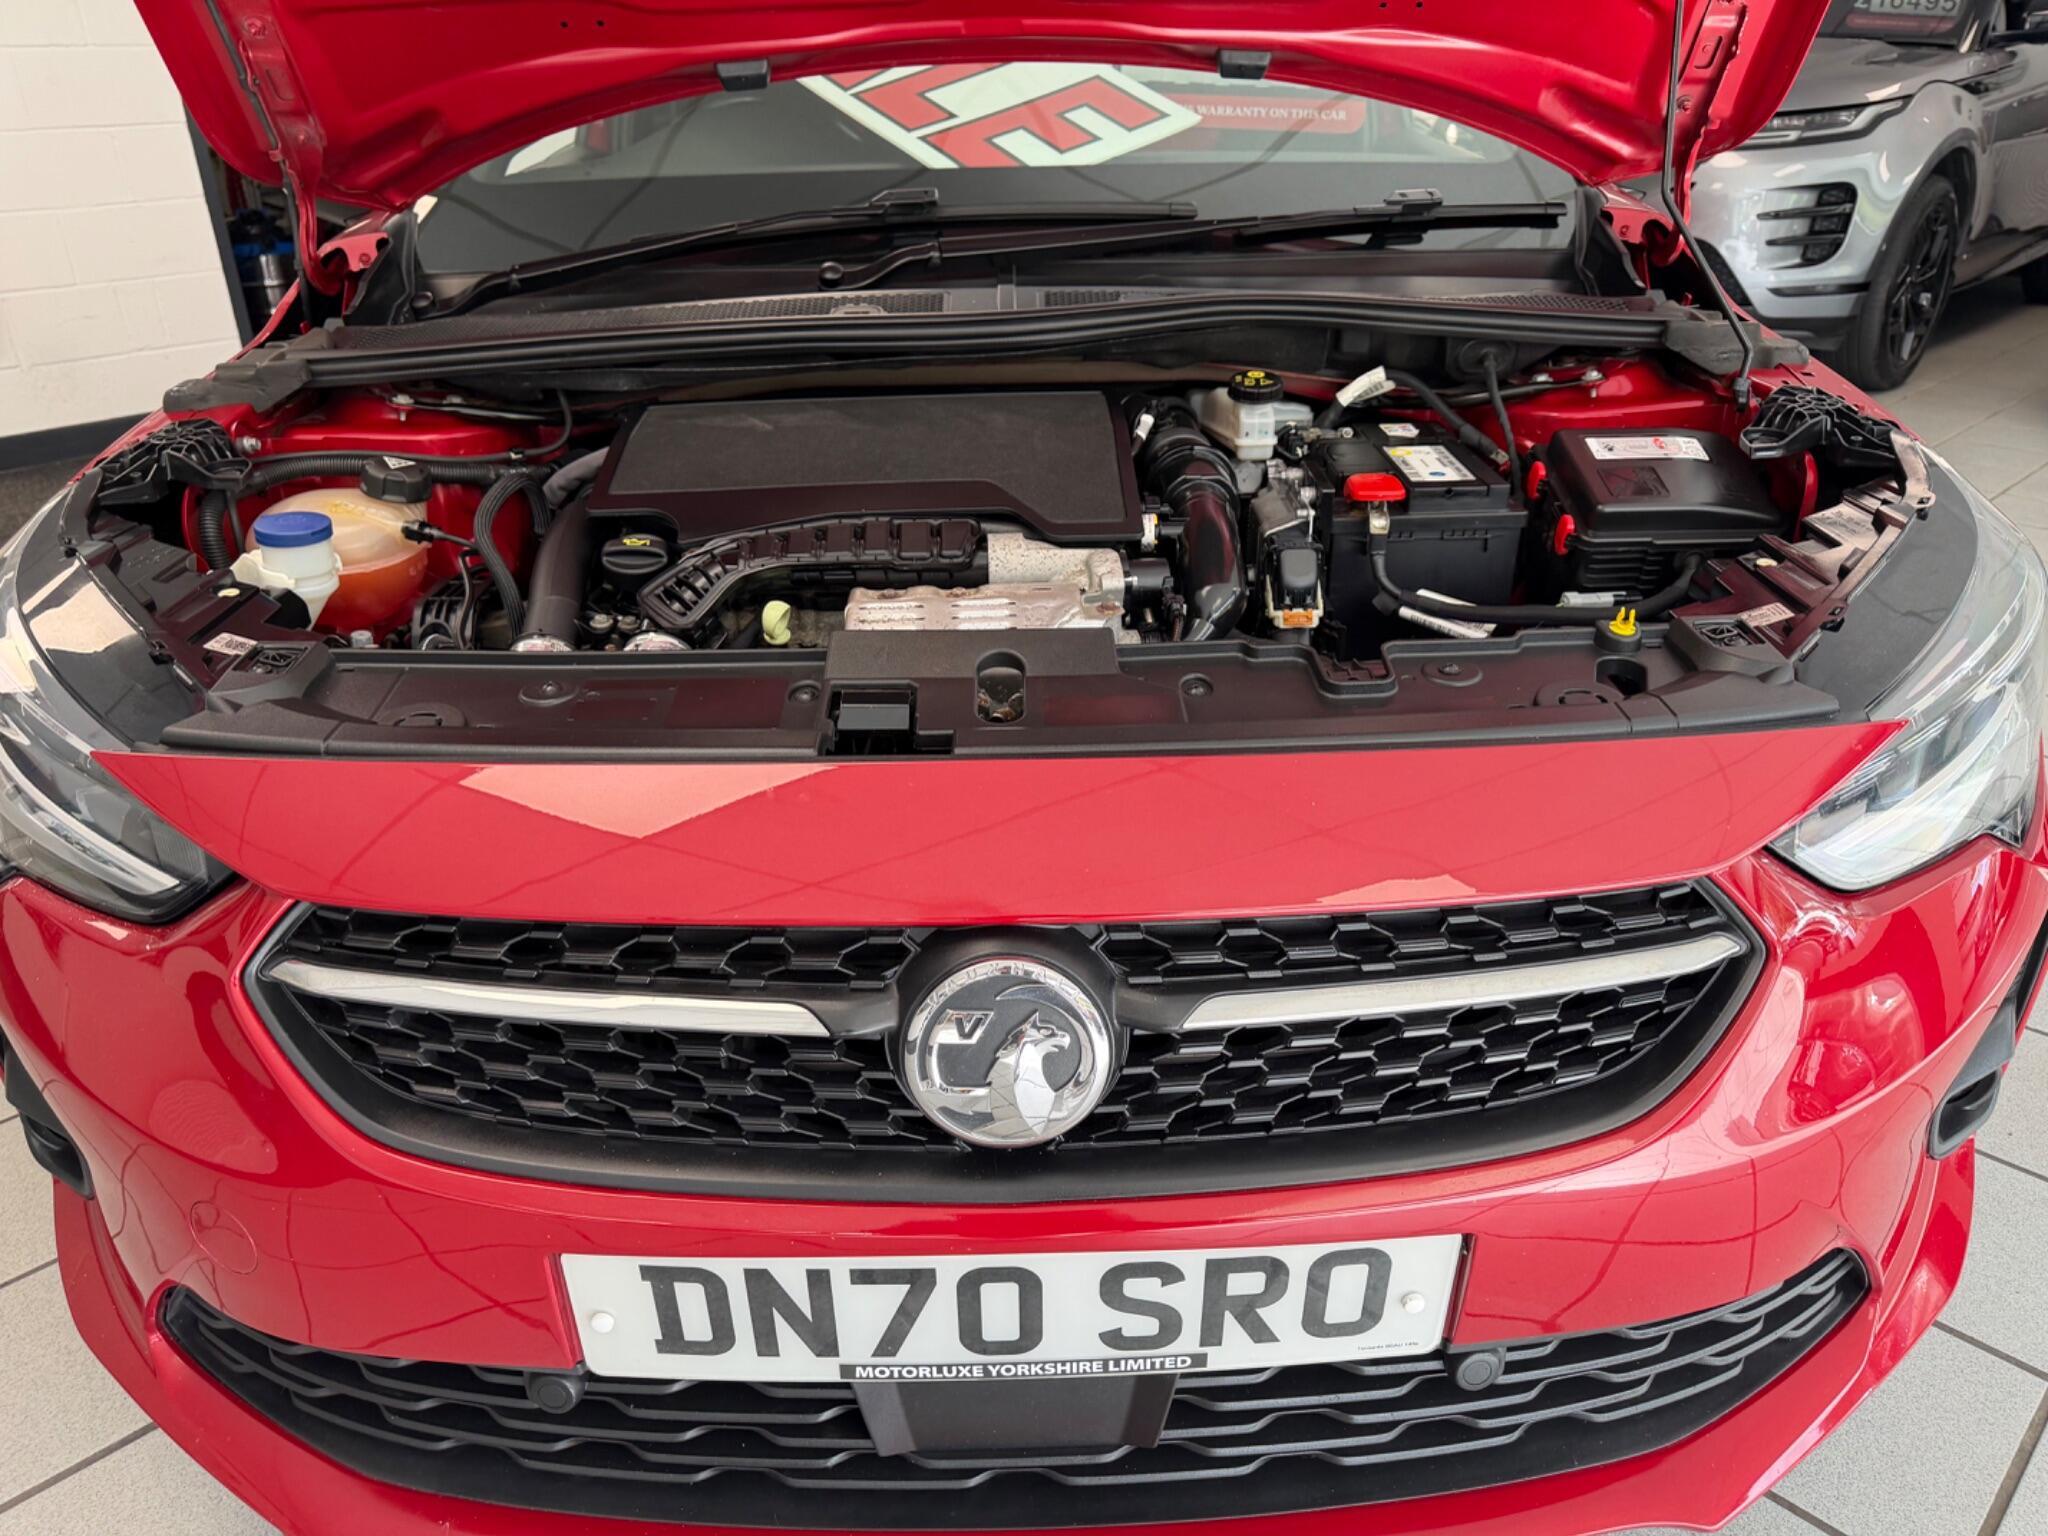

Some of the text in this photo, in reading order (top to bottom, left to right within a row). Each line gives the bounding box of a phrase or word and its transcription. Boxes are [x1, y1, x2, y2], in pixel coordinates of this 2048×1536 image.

[1196, 104, 1267, 118] WARRANTY
[1270, 107, 1288, 119] ON
[1321, 109, 1346, 121] CAR
[638, 1247, 1393, 1358] DN70 SRO
[854, 1355, 1192, 1379] MOTORLUXE YORKSHIRE LIMITED
